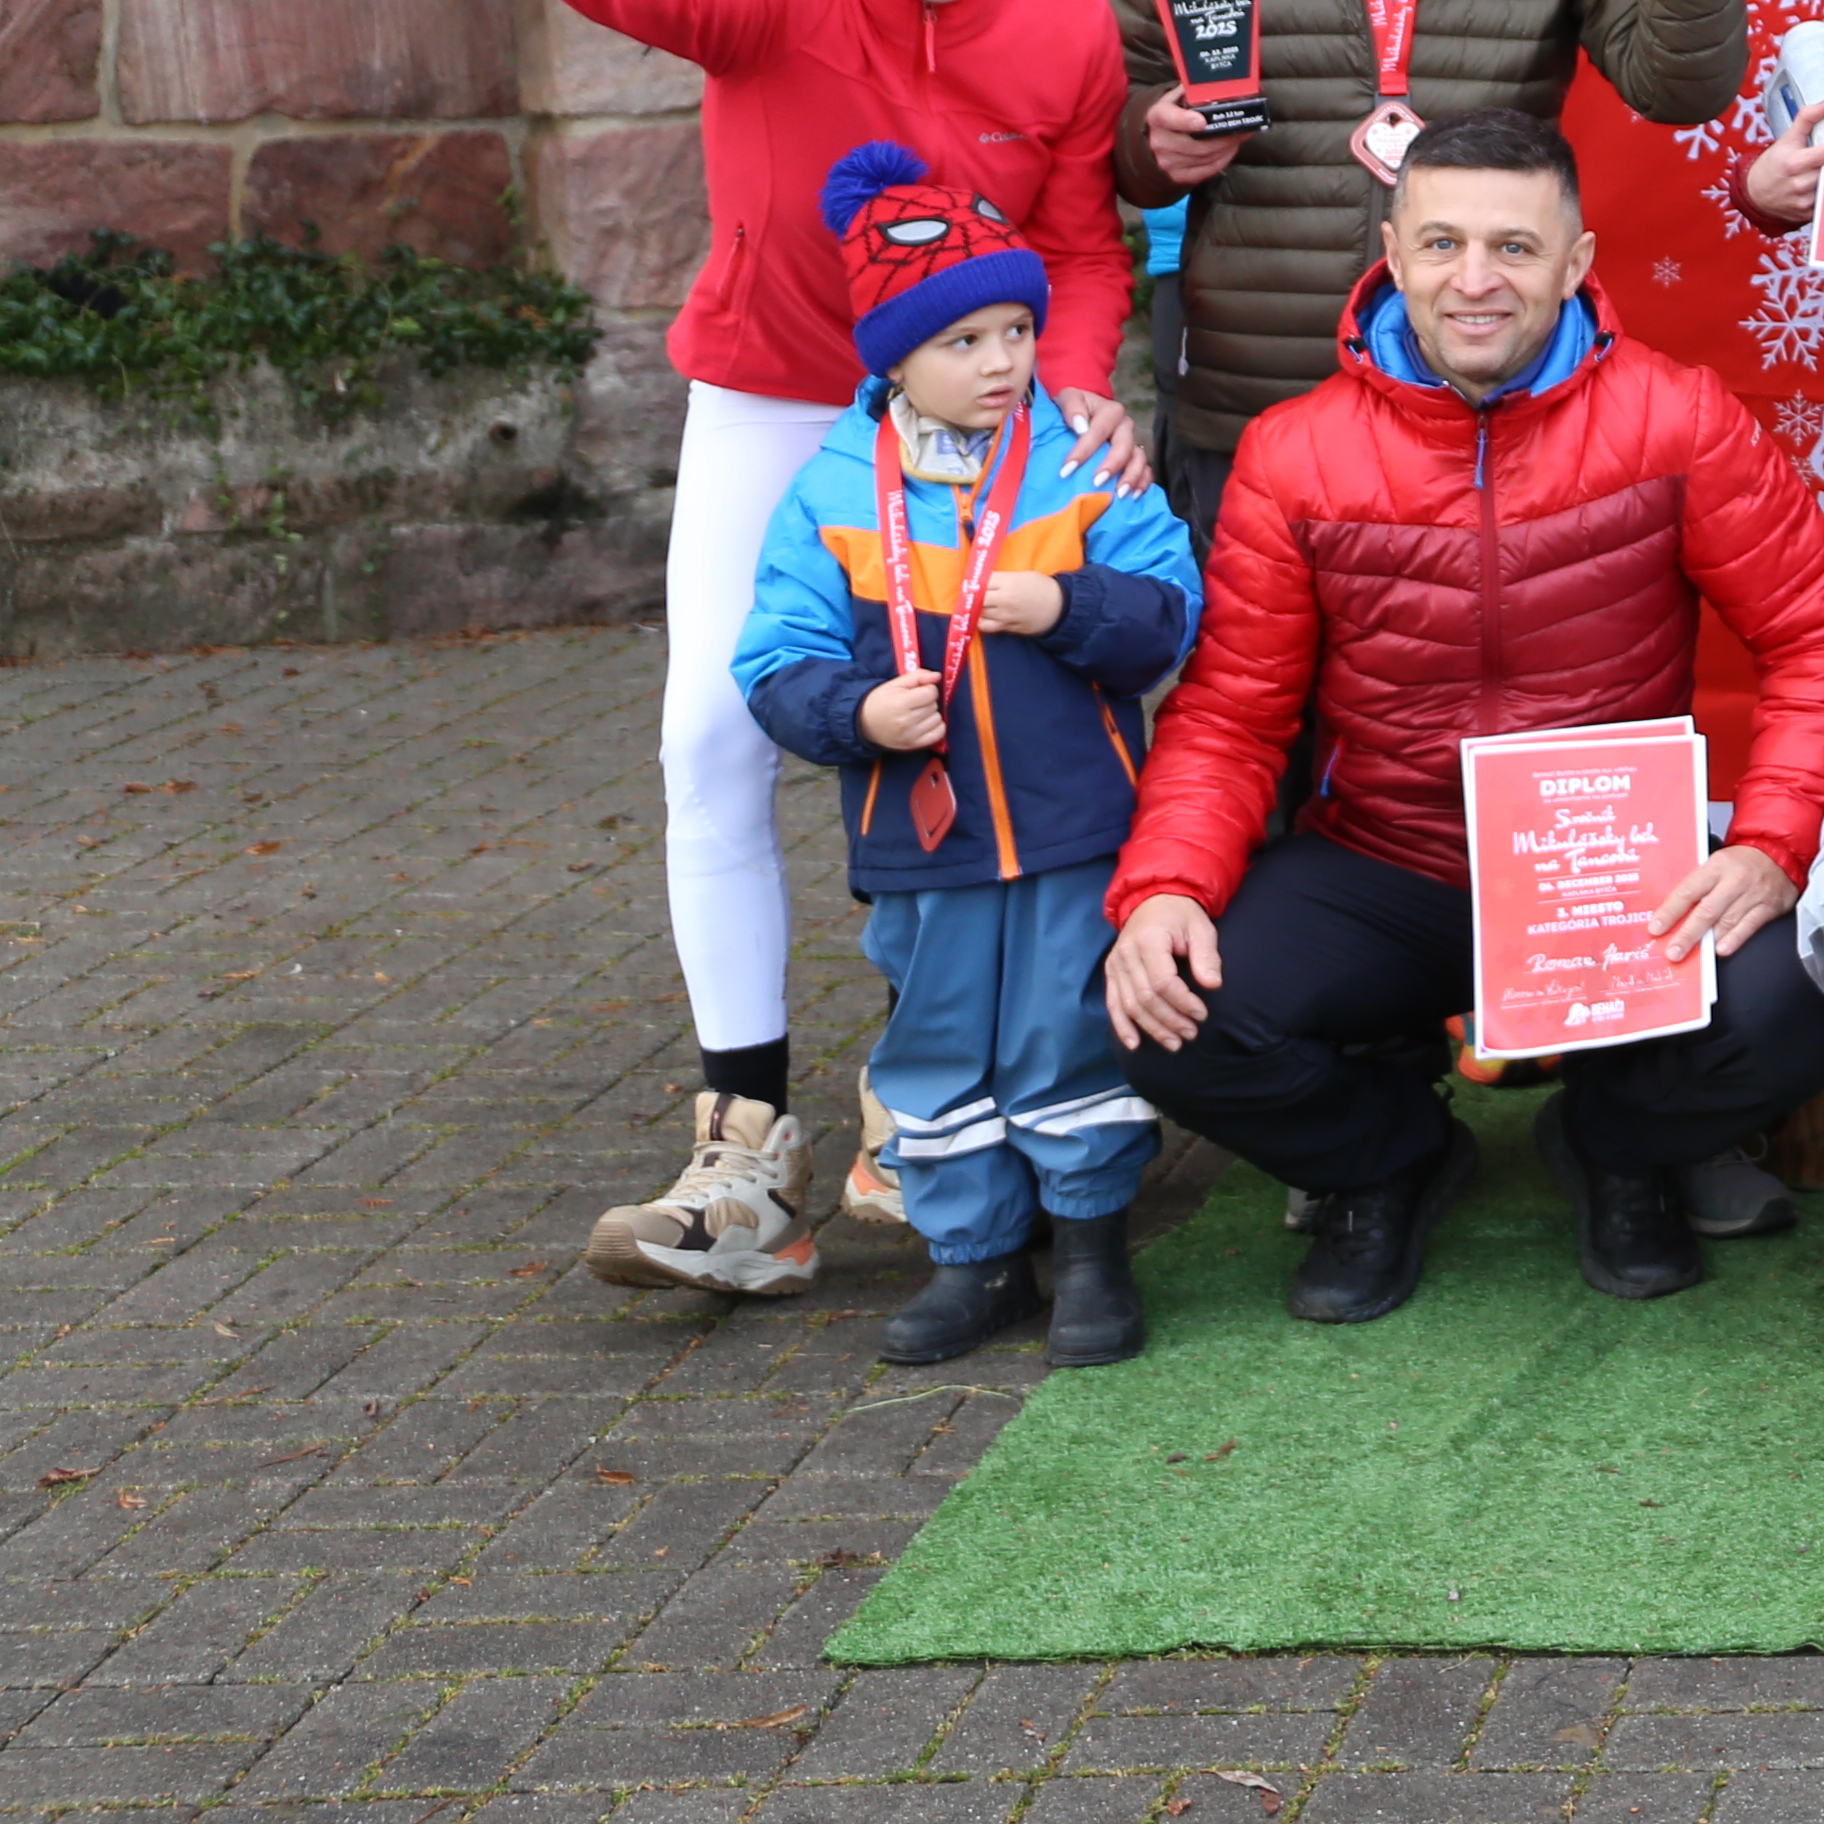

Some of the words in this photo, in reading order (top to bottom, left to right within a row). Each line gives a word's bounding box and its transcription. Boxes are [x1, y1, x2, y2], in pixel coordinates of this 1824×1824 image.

[1196, 20, 1237, 39] 2025
[978, 510, 1000, 547] 2025
[1539, 774, 1631, 796] DIPLOM
[1556, 906, 1569, 919] 3.
[1571, 900, 1624, 916] MIESTO
[1526, 917, 1599, 935] KATEGÓRIA
[1601, 910, 1655, 926] TROJICE
